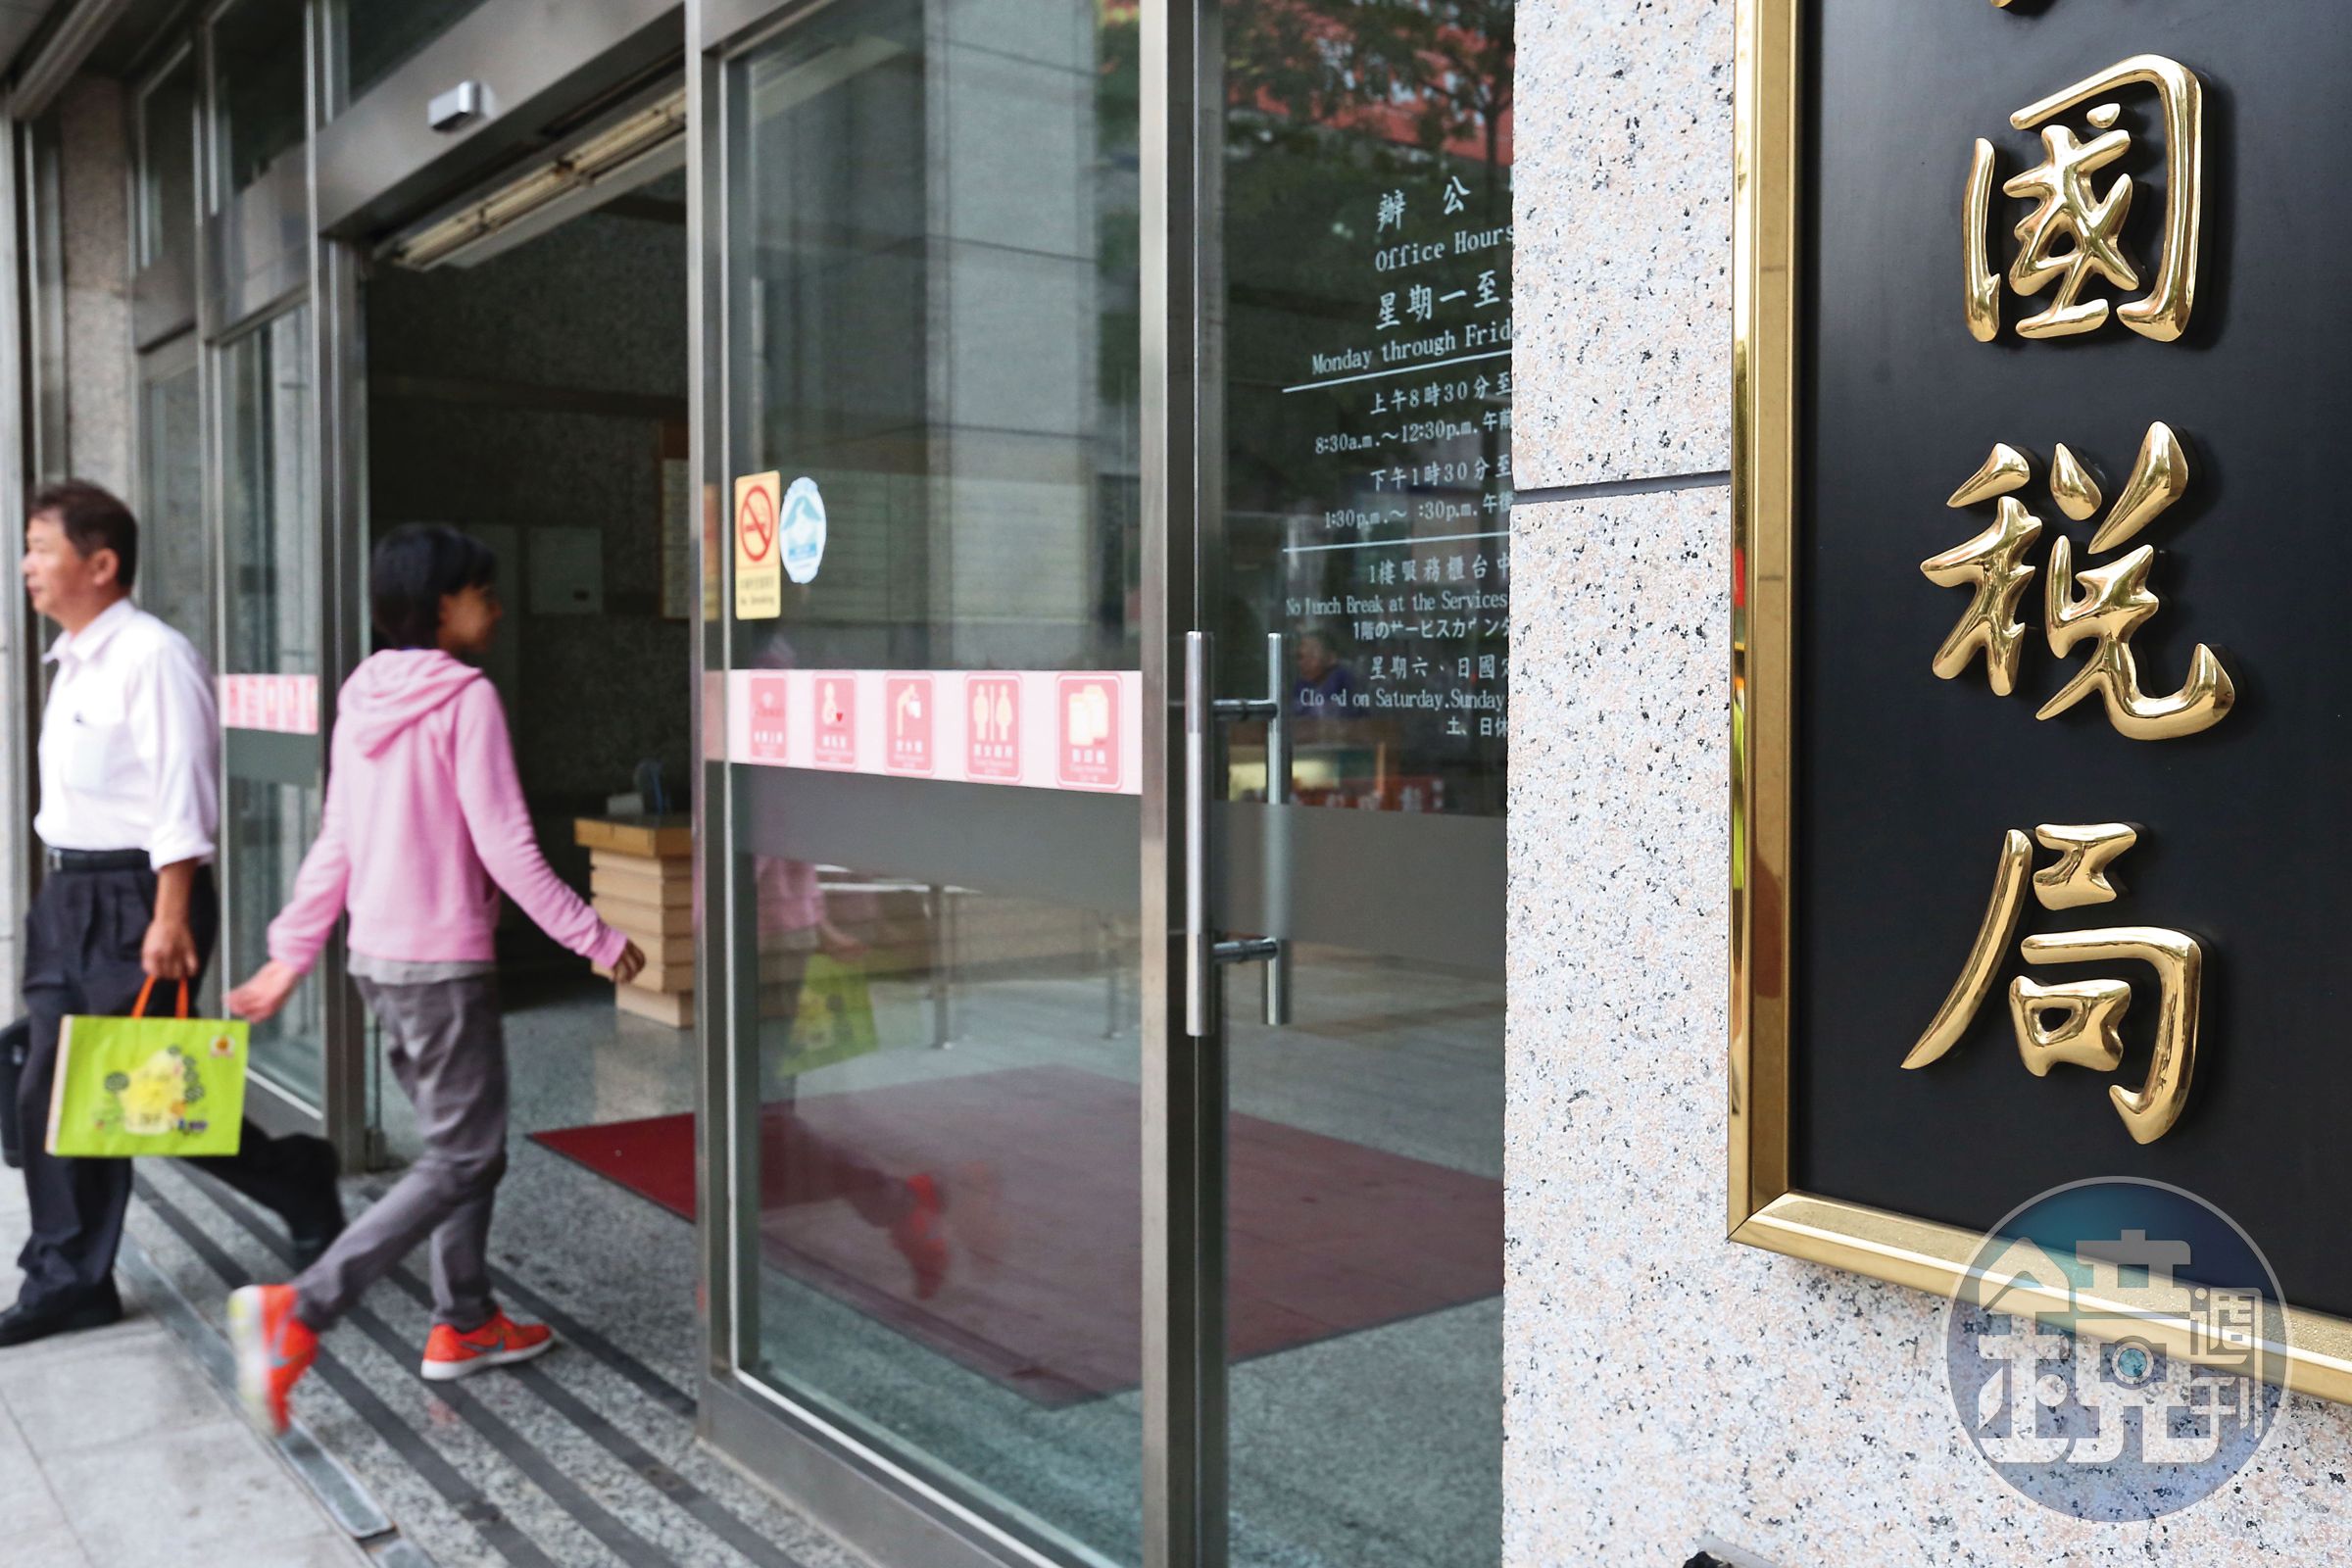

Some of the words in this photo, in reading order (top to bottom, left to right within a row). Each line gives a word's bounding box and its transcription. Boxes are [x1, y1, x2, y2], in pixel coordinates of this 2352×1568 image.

[1375, 242, 1446, 272] Office
[1453, 224, 1514, 255] Hours
[1375, 270, 1514, 331] 星期一至
[1311, 347, 1372, 375] Monday
[1381, 329, 1456, 363] through
[1347, 594, 1385, 614] Break
[1389, 596, 1406, 613] at
[1413, 593, 1436, 612] the
[1442, 589, 1508, 612] Services
[1299, 688, 1347, 708] Cloed
[1352, 692, 1371, 708] on
